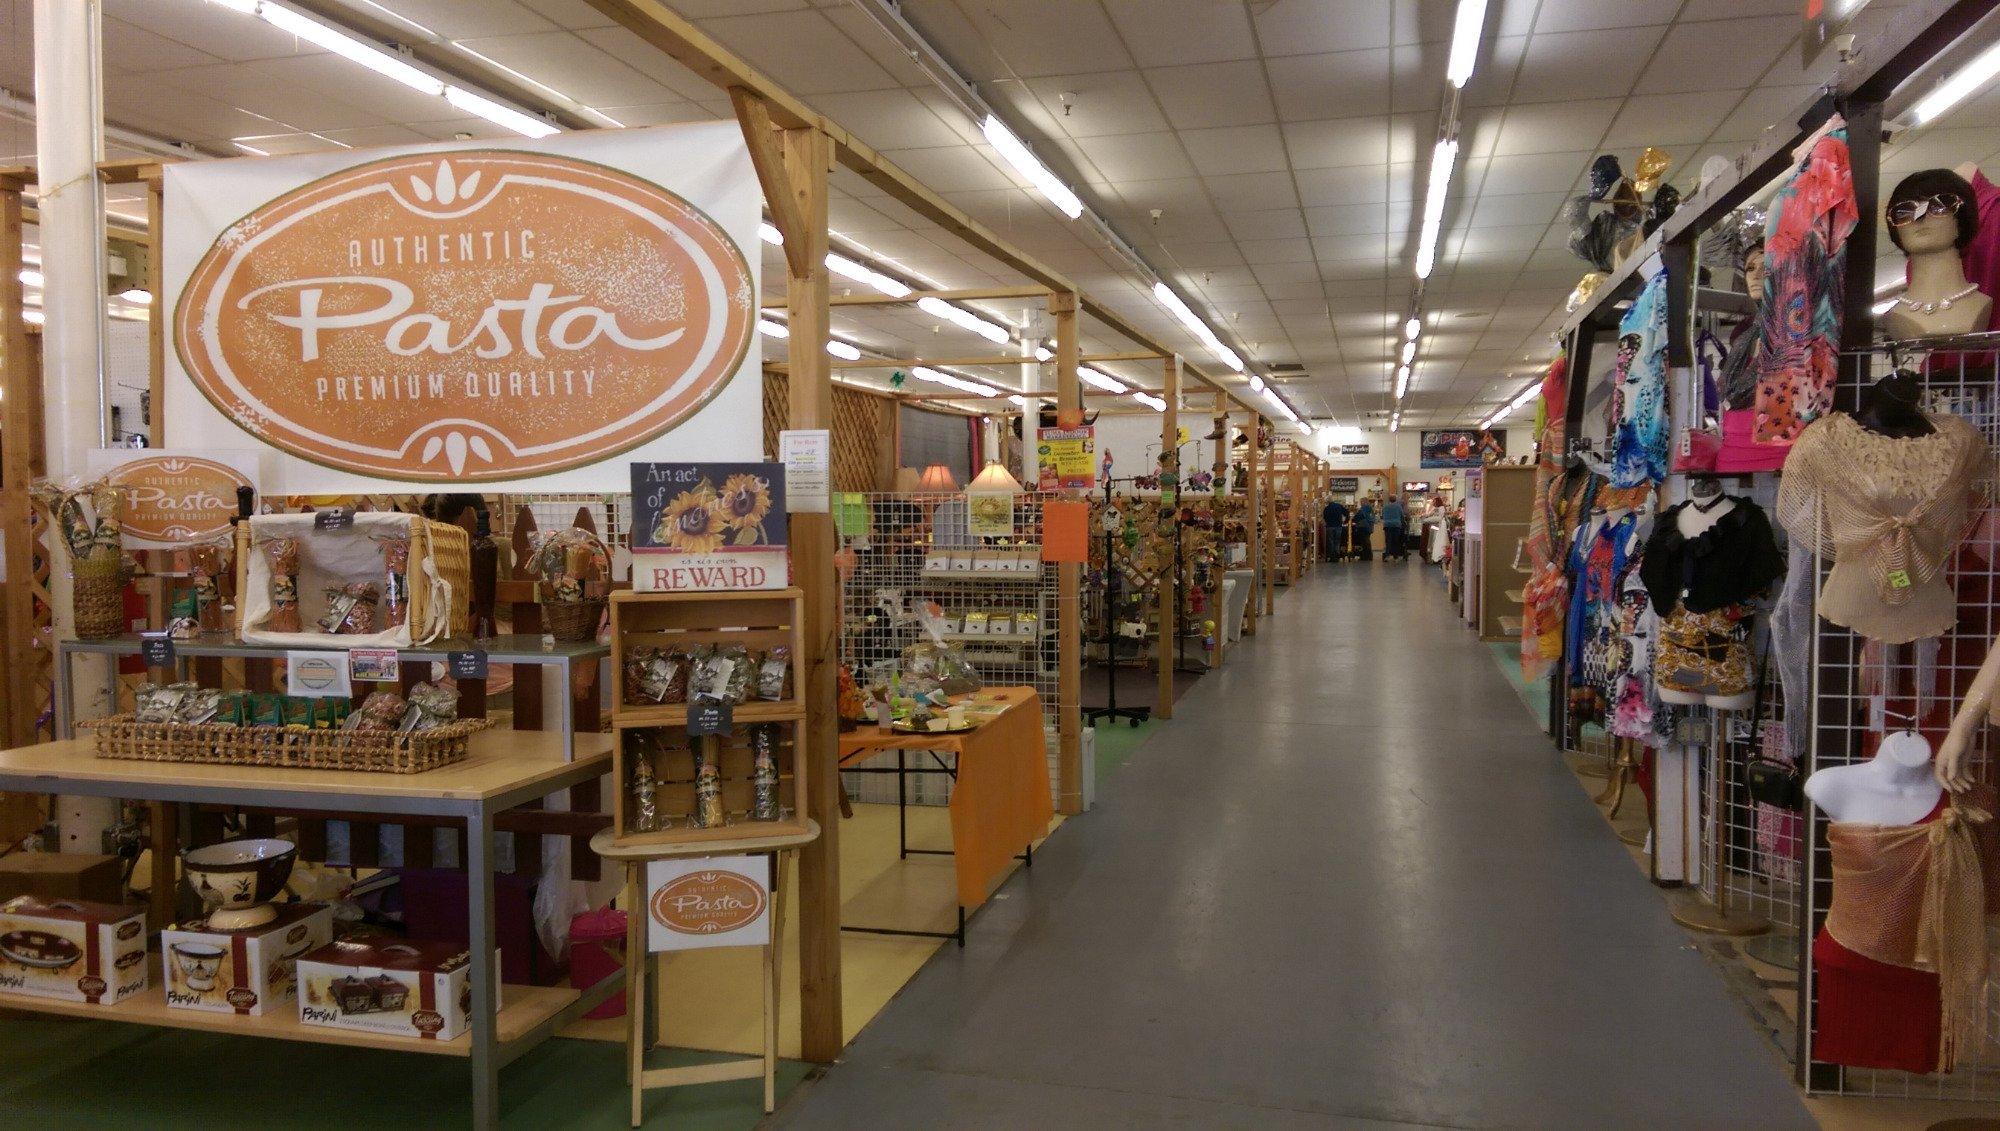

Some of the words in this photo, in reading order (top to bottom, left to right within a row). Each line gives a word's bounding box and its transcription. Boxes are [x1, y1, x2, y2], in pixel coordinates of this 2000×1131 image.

[349, 229, 536, 268] AUTHENTIC
[237, 275, 686, 363] Pasta
[317, 372, 445, 402] PREMIUM
[465, 369, 596, 399] QUALITY
[145, 477, 200, 486] AUTHENTIC
[646, 462, 671, 482] An
[675, 466, 699, 482] act
[120, 486, 240, 511] Pasta
[647, 486, 665, 508] of
[135, 513, 175, 521] PREMIUM
[180, 512, 217, 521] QUALITY
[653, 566, 766, 590] REWARD
[687, 885, 728, 893] AUTHENTIC
[664, 894, 754, 914] Pasta
[712, 911, 738, 919] QUALITY
